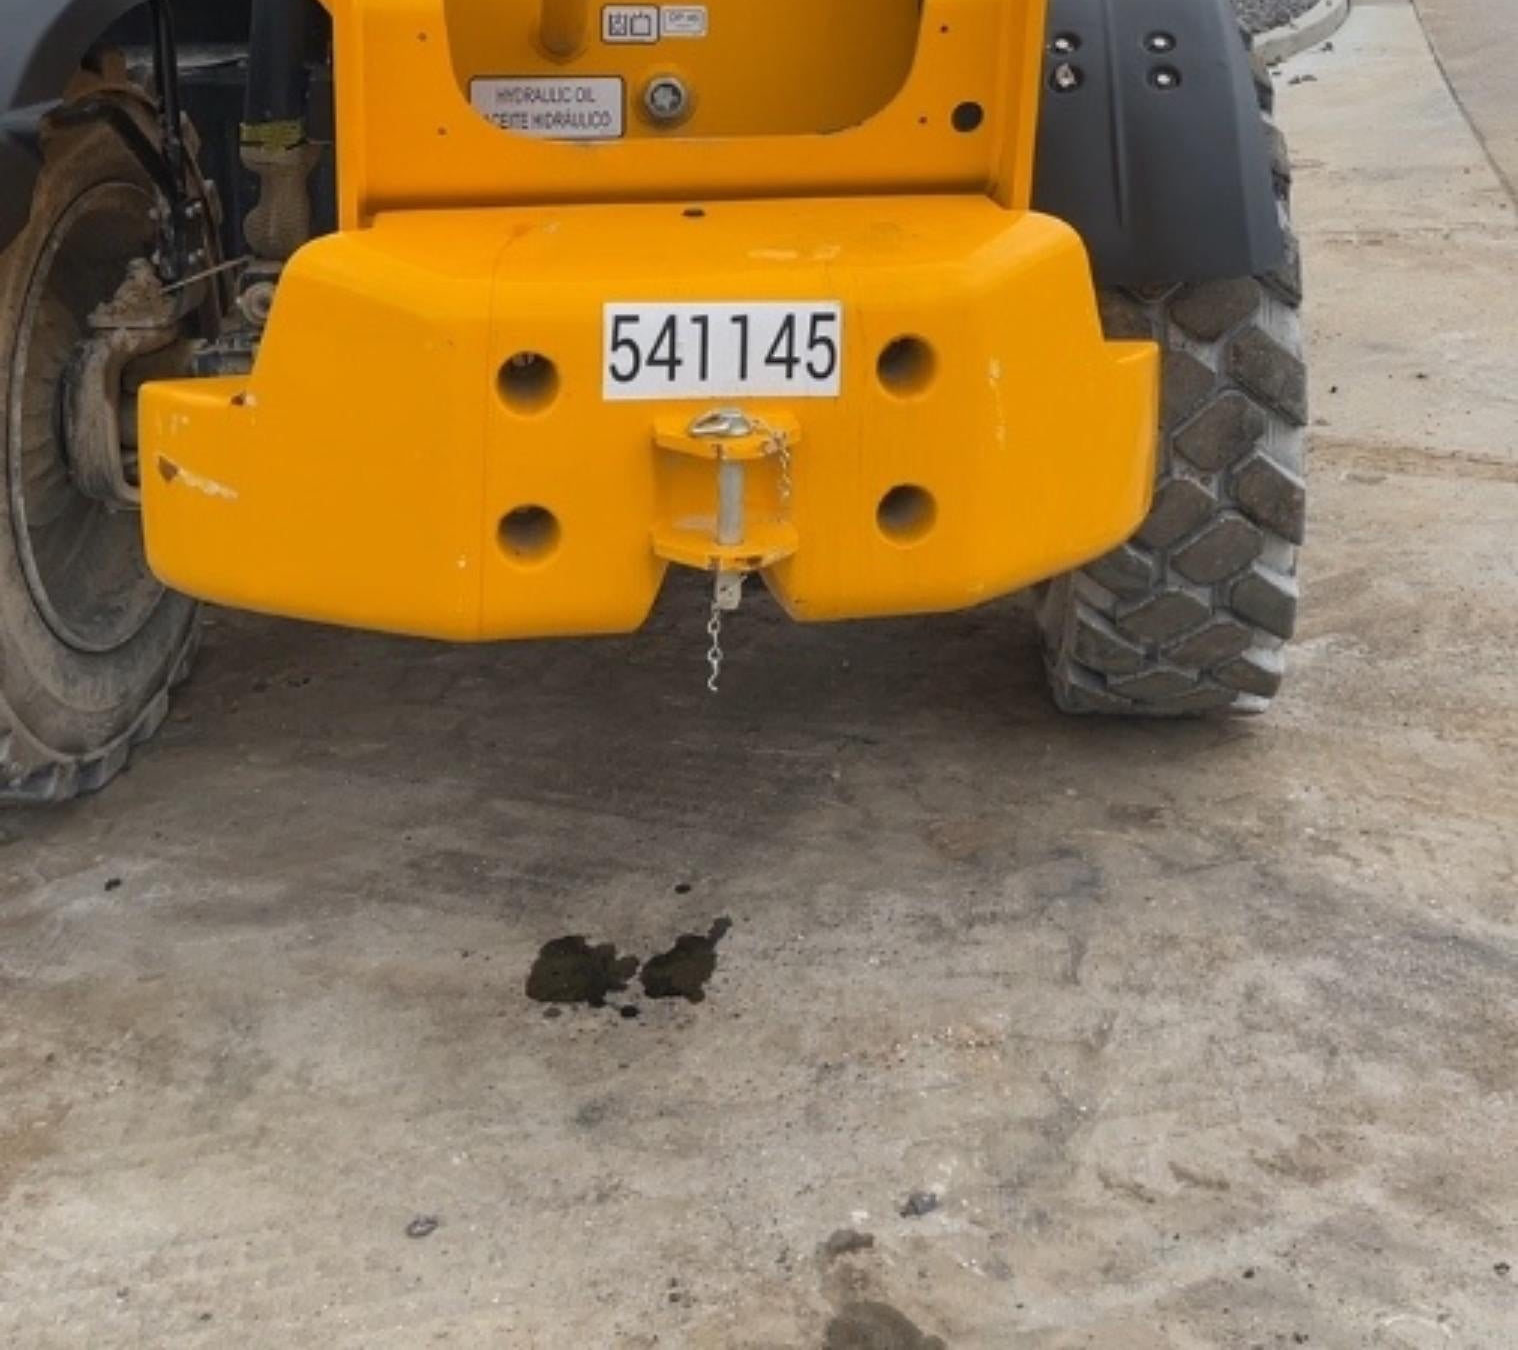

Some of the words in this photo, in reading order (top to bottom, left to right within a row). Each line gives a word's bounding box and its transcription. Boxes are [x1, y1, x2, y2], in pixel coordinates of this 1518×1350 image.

[496, 86, 571, 104] HYDRAULIC
[576, 86, 597, 104] OIL
[609, 313, 837, 383] 541145
